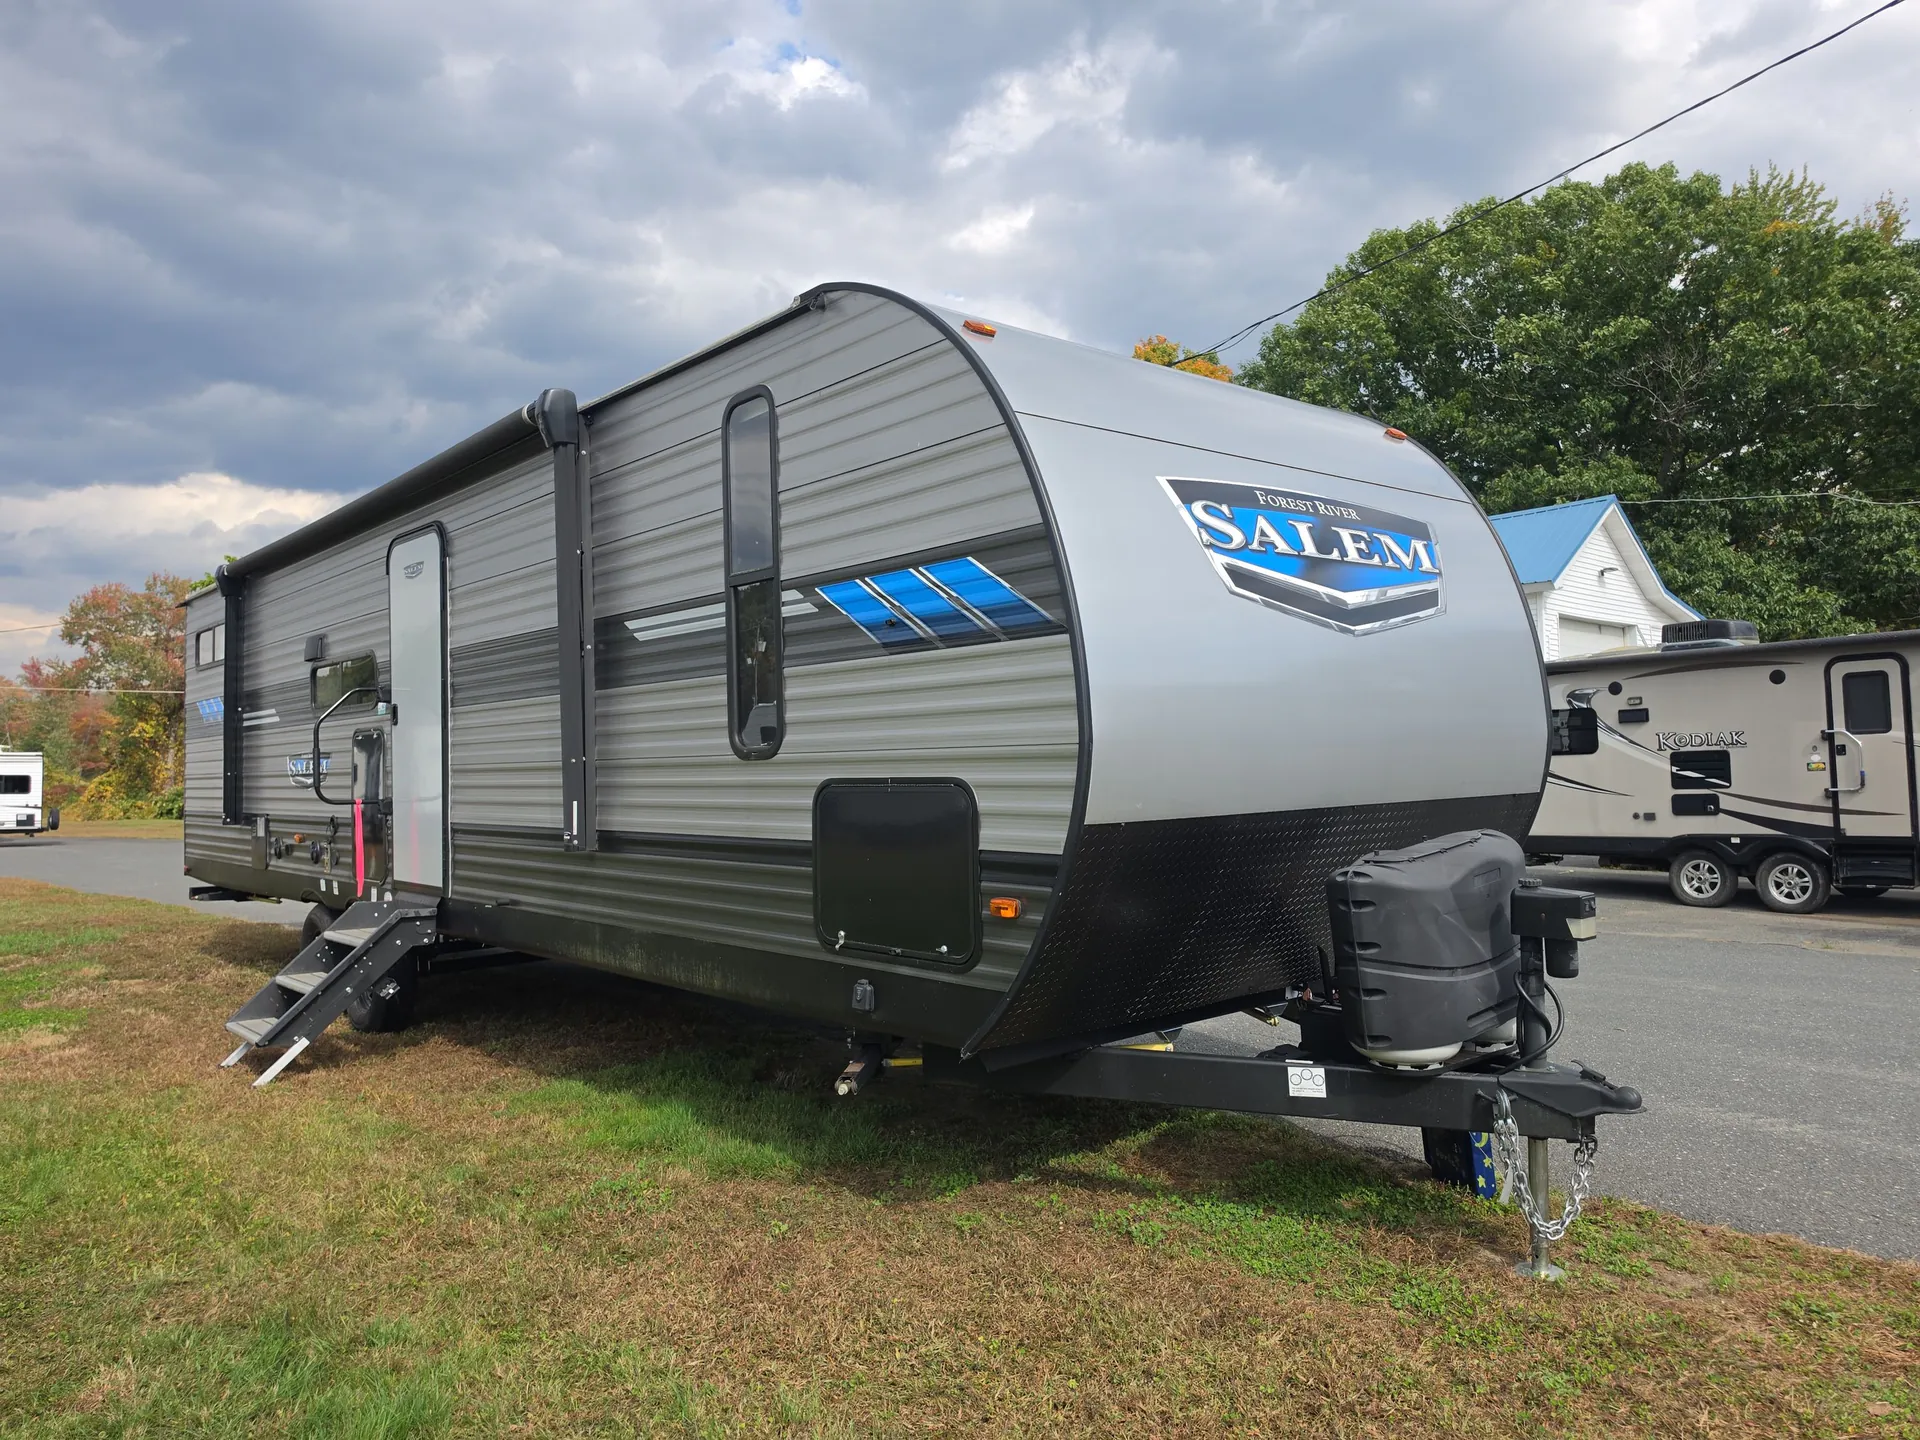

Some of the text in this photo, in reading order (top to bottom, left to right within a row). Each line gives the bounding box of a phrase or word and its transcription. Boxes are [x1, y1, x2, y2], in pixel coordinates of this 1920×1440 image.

[1254, 490, 1361, 520] FOREST RIVER
[1190, 500, 1440, 574] SALEM
[1655, 730, 1747, 751] KODIAK
